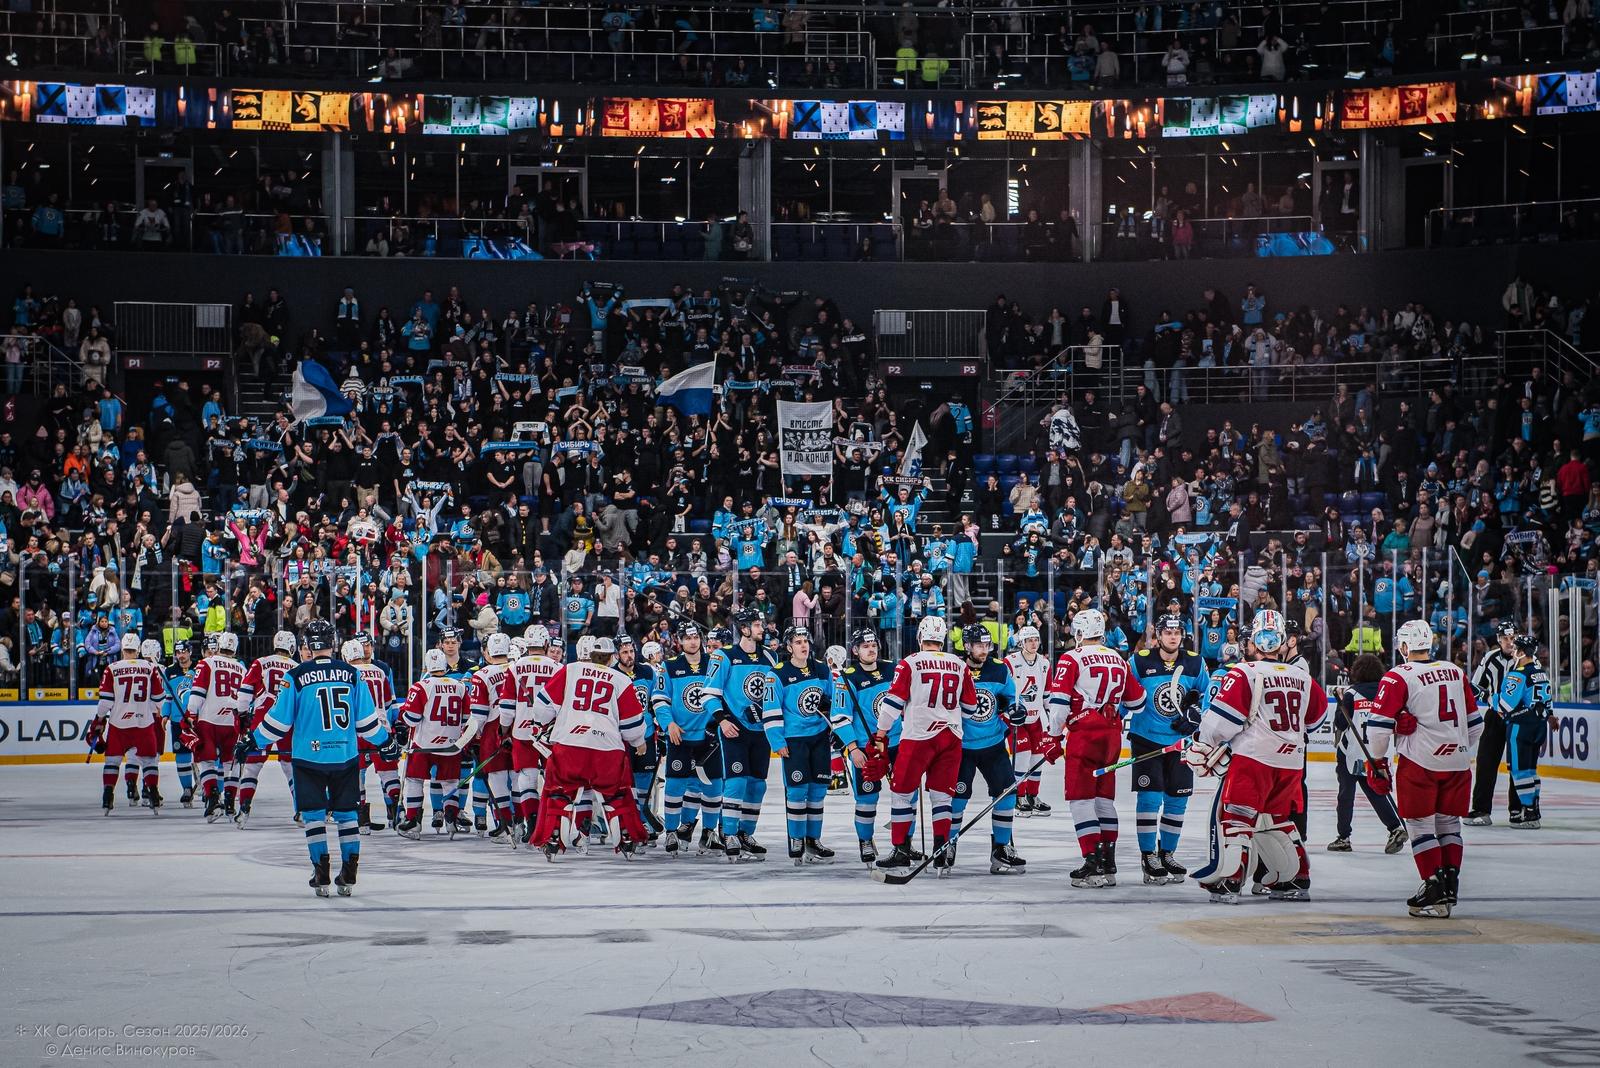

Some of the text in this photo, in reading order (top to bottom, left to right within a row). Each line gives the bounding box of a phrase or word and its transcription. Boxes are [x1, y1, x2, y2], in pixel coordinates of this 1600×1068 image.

[129, 359, 141, 367] P1
[207, 360, 220, 368] P2
[888, 366, 901, 374] P2
[964, 366, 976, 374] P3
[559, 440, 590, 449] СИБИРЬ
[805, 453, 830, 464] КОНЦА
[895, 476, 922, 484] СИБИРЬ
[774, 496, 807, 505] СИБИРЬ
[516, 664, 554, 675] RADULOV
[582, 667, 614, 682] ISAYEV
[1417, 669, 1459, 686] YELESIN
[118, 676, 148, 703] 73
[214, 669, 243, 700] 89
[435, 684, 457, 694] ULYEV
[921, 672, 960, 710] 78
[1090, 666, 1125, 705] 72
[1253, 673, 1305, 692] ELNICHUK
[572, 678, 614, 715] 92
[316, 685, 352, 732] 15
[430, 695, 462, 727] 49
[1265, 691, 1302, 732] 38
[1438, 684, 1459, 727] 4
[1538, 716, 1590, 761] газ
